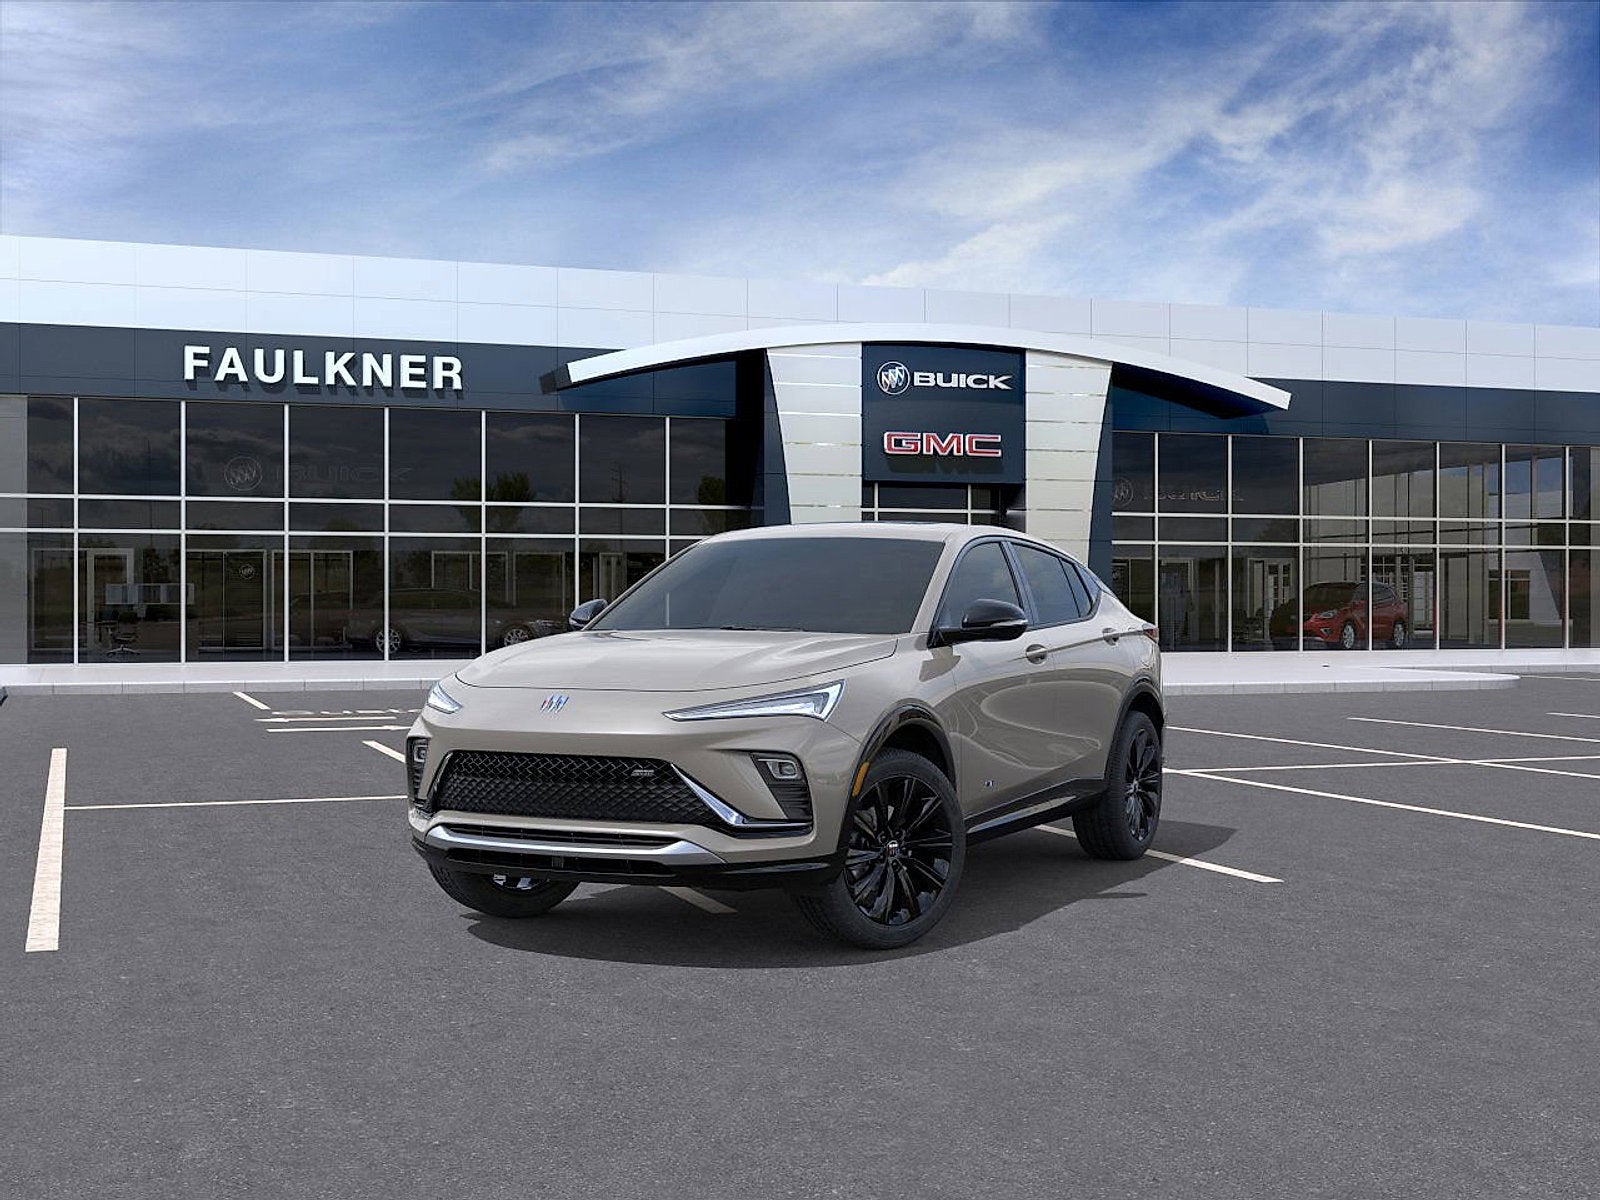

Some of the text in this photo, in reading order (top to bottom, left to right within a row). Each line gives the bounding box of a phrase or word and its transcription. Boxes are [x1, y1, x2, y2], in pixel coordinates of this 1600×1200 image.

[184, 345, 463, 390] FAULKNER
[914, 371, 1013, 390] BUICK
[883, 431, 1002, 457] GMC
